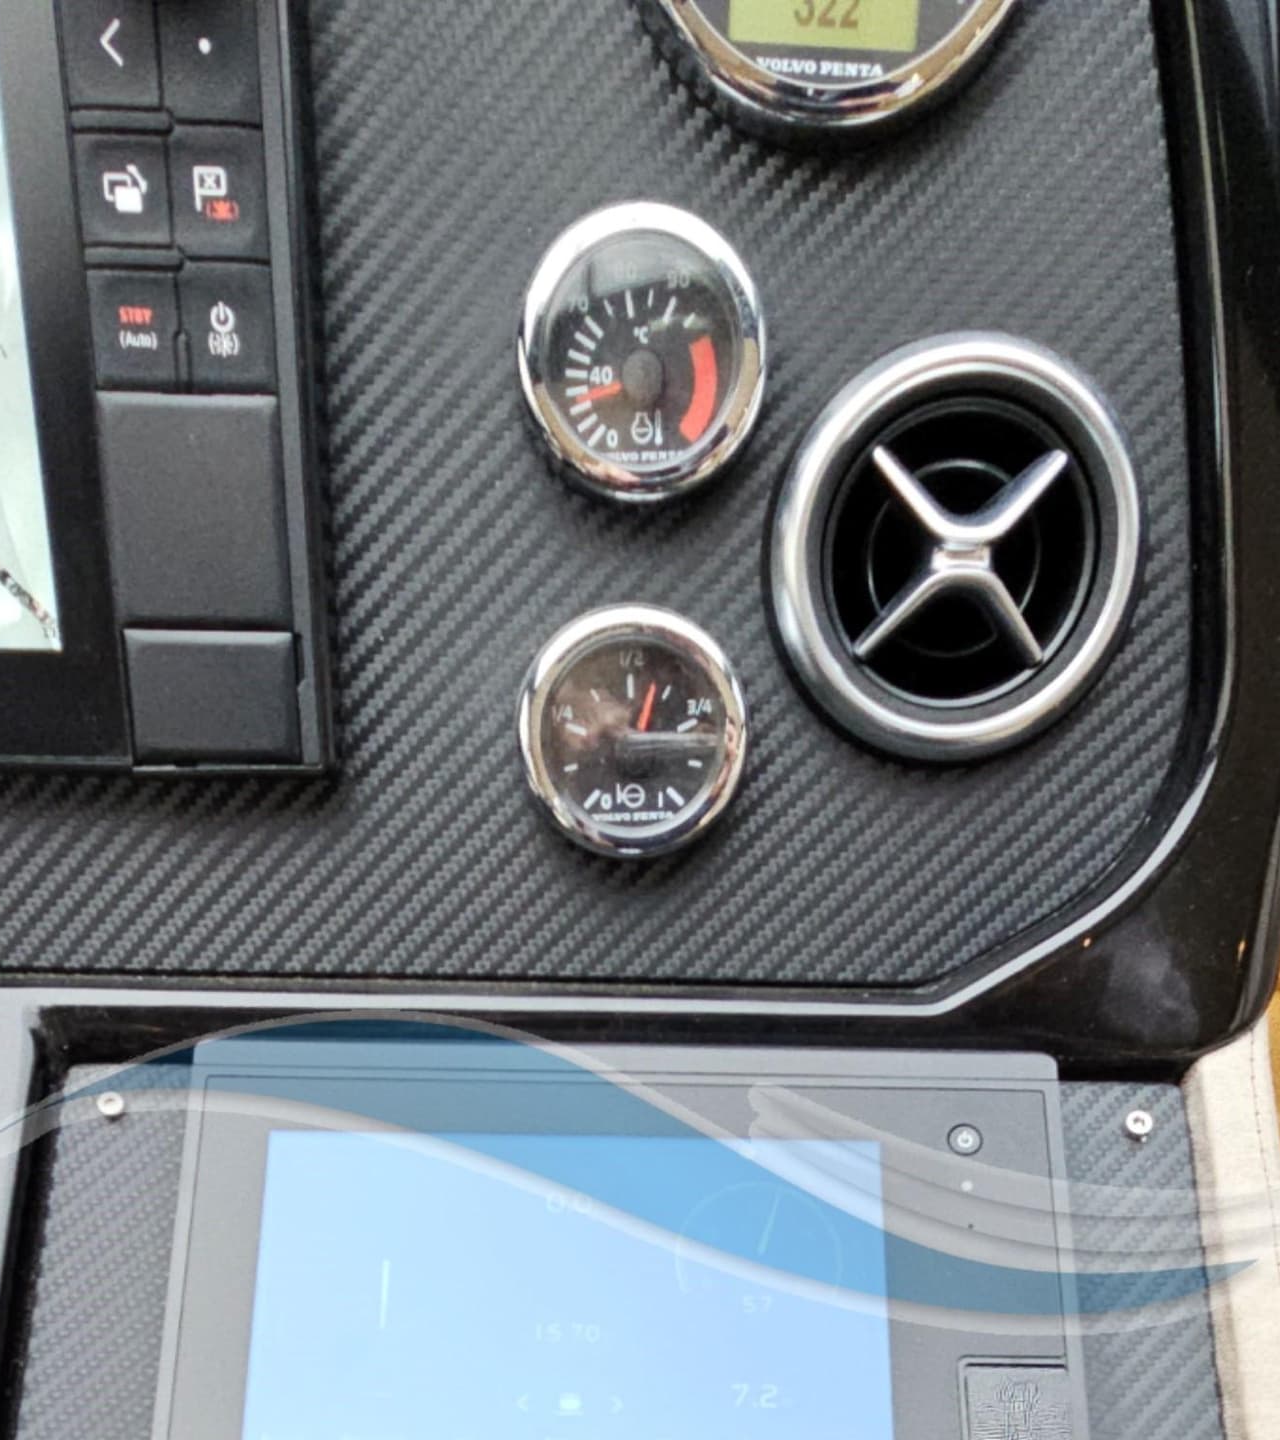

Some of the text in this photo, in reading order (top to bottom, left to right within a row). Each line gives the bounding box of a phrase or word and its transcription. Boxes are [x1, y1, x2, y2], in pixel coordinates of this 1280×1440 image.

[756, 56, 884, 78] VOLVO PENTA
[589, 365, 613, 384] 40
[605, 431, 619, 449] 0
[686, 698, 712, 715] 3/4
